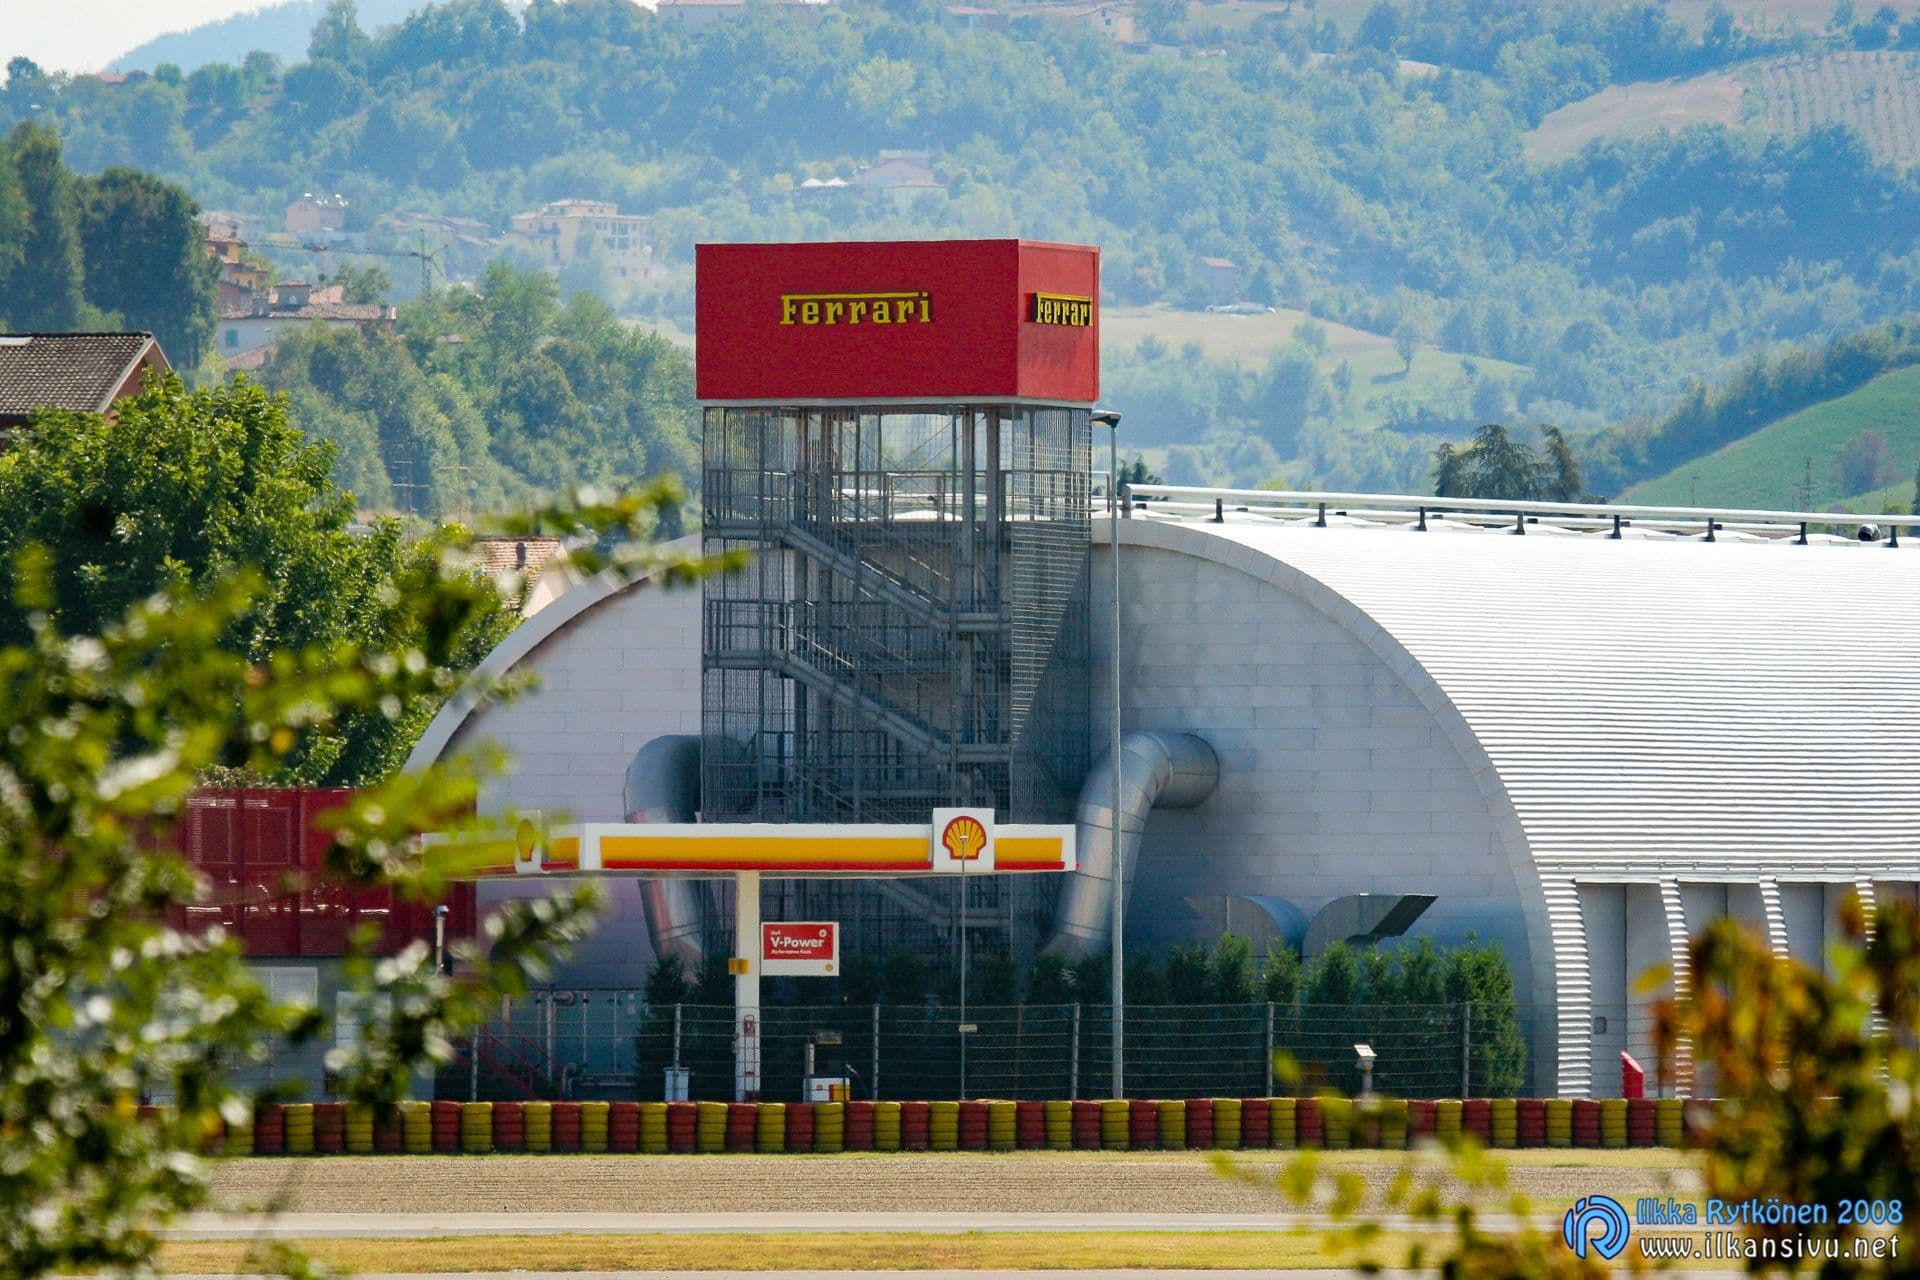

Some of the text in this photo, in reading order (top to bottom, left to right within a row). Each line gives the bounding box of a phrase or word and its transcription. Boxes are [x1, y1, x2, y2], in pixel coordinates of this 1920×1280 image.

[780, 292, 930, 325] Ferrari
[1036, 292, 1093, 327] Ferrari
[770, 936, 824, 948] V-Power
